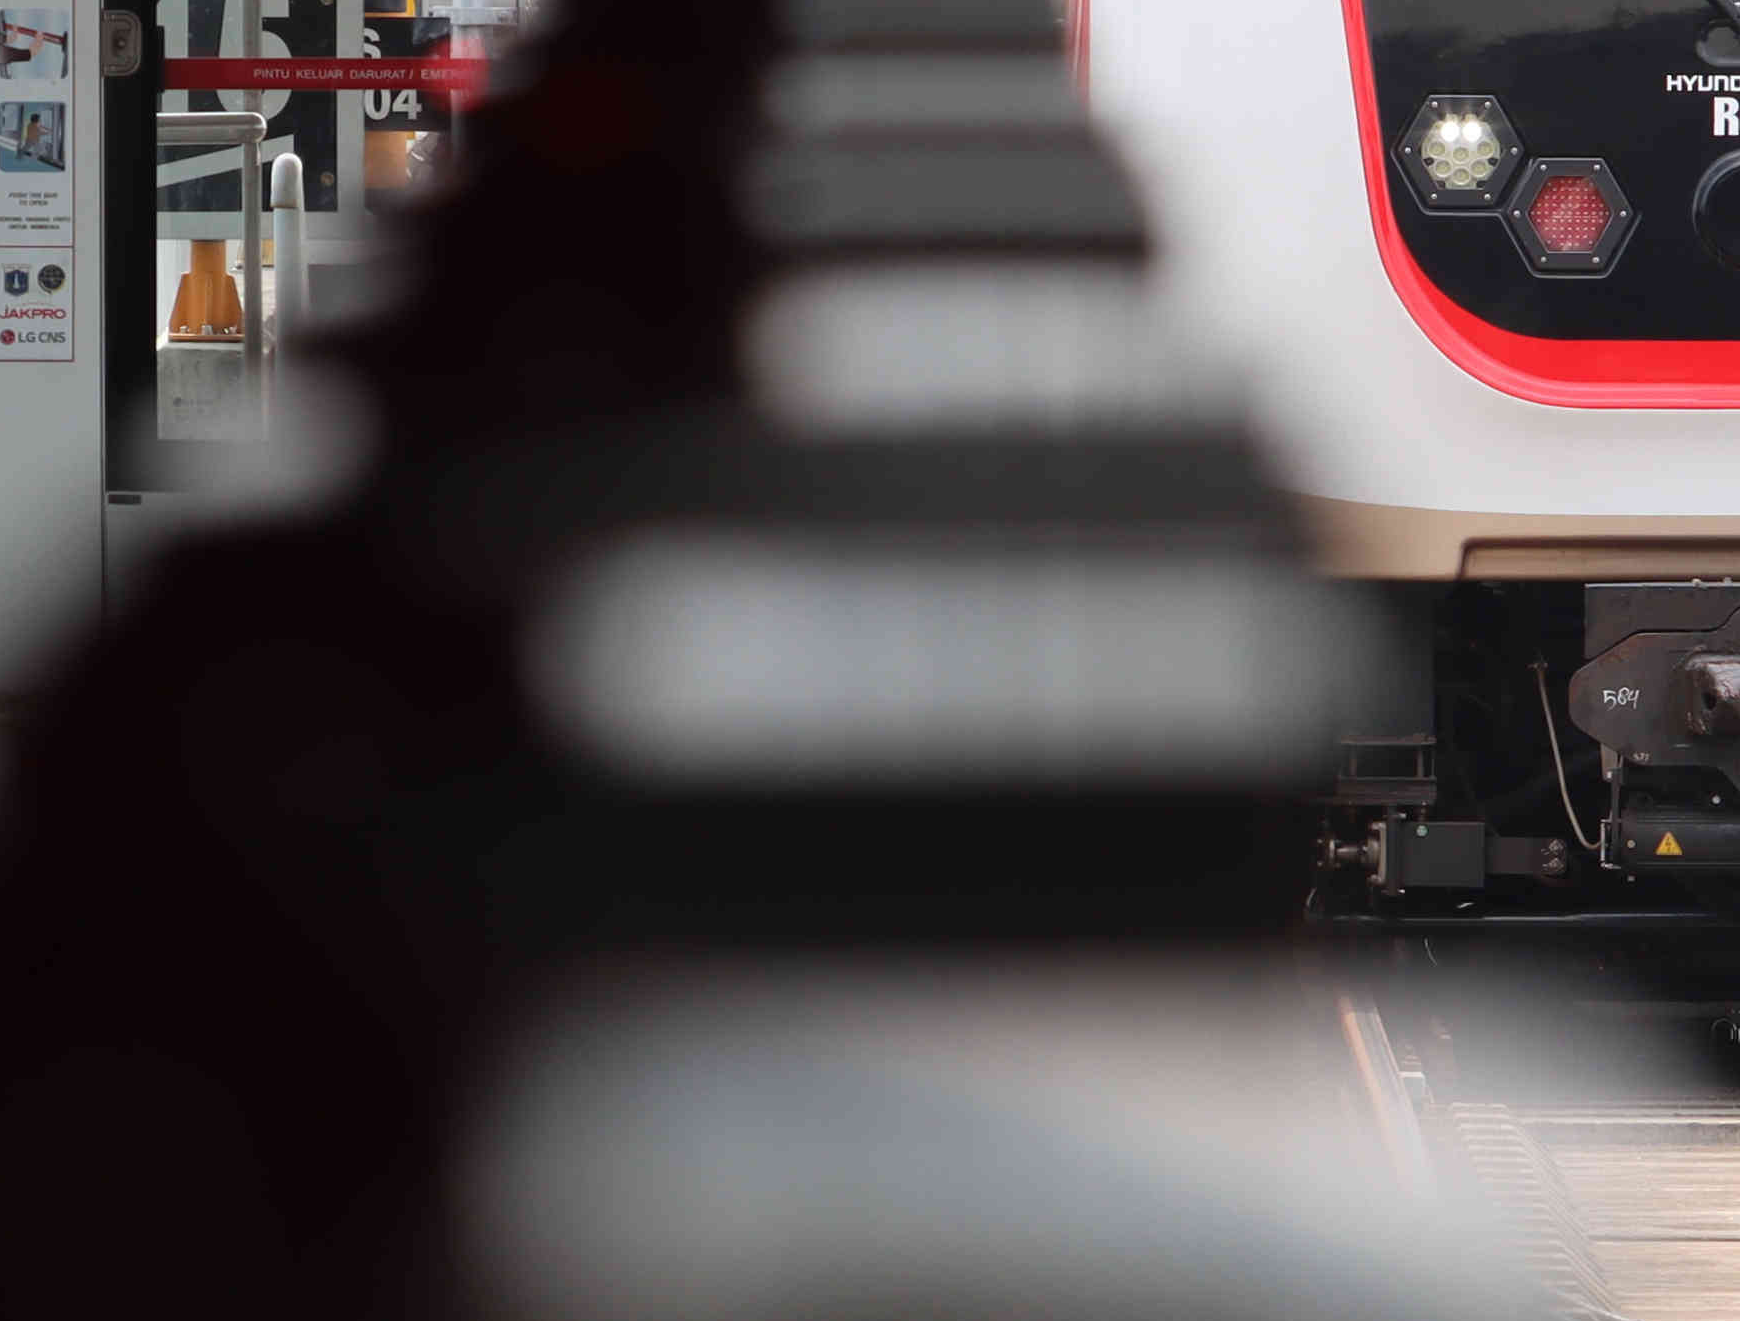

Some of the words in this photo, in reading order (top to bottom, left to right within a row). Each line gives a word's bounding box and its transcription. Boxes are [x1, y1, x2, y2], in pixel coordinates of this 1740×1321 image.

[253, 69, 289, 80] PINTU
[296, 69, 343, 80] KELUAR
[0, 304, 67, 319] JAKPRO
[18, 332, 36, 343] LG
[38, 331, 66, 343] CNS
[1602, 686, 1640, 711] 584
